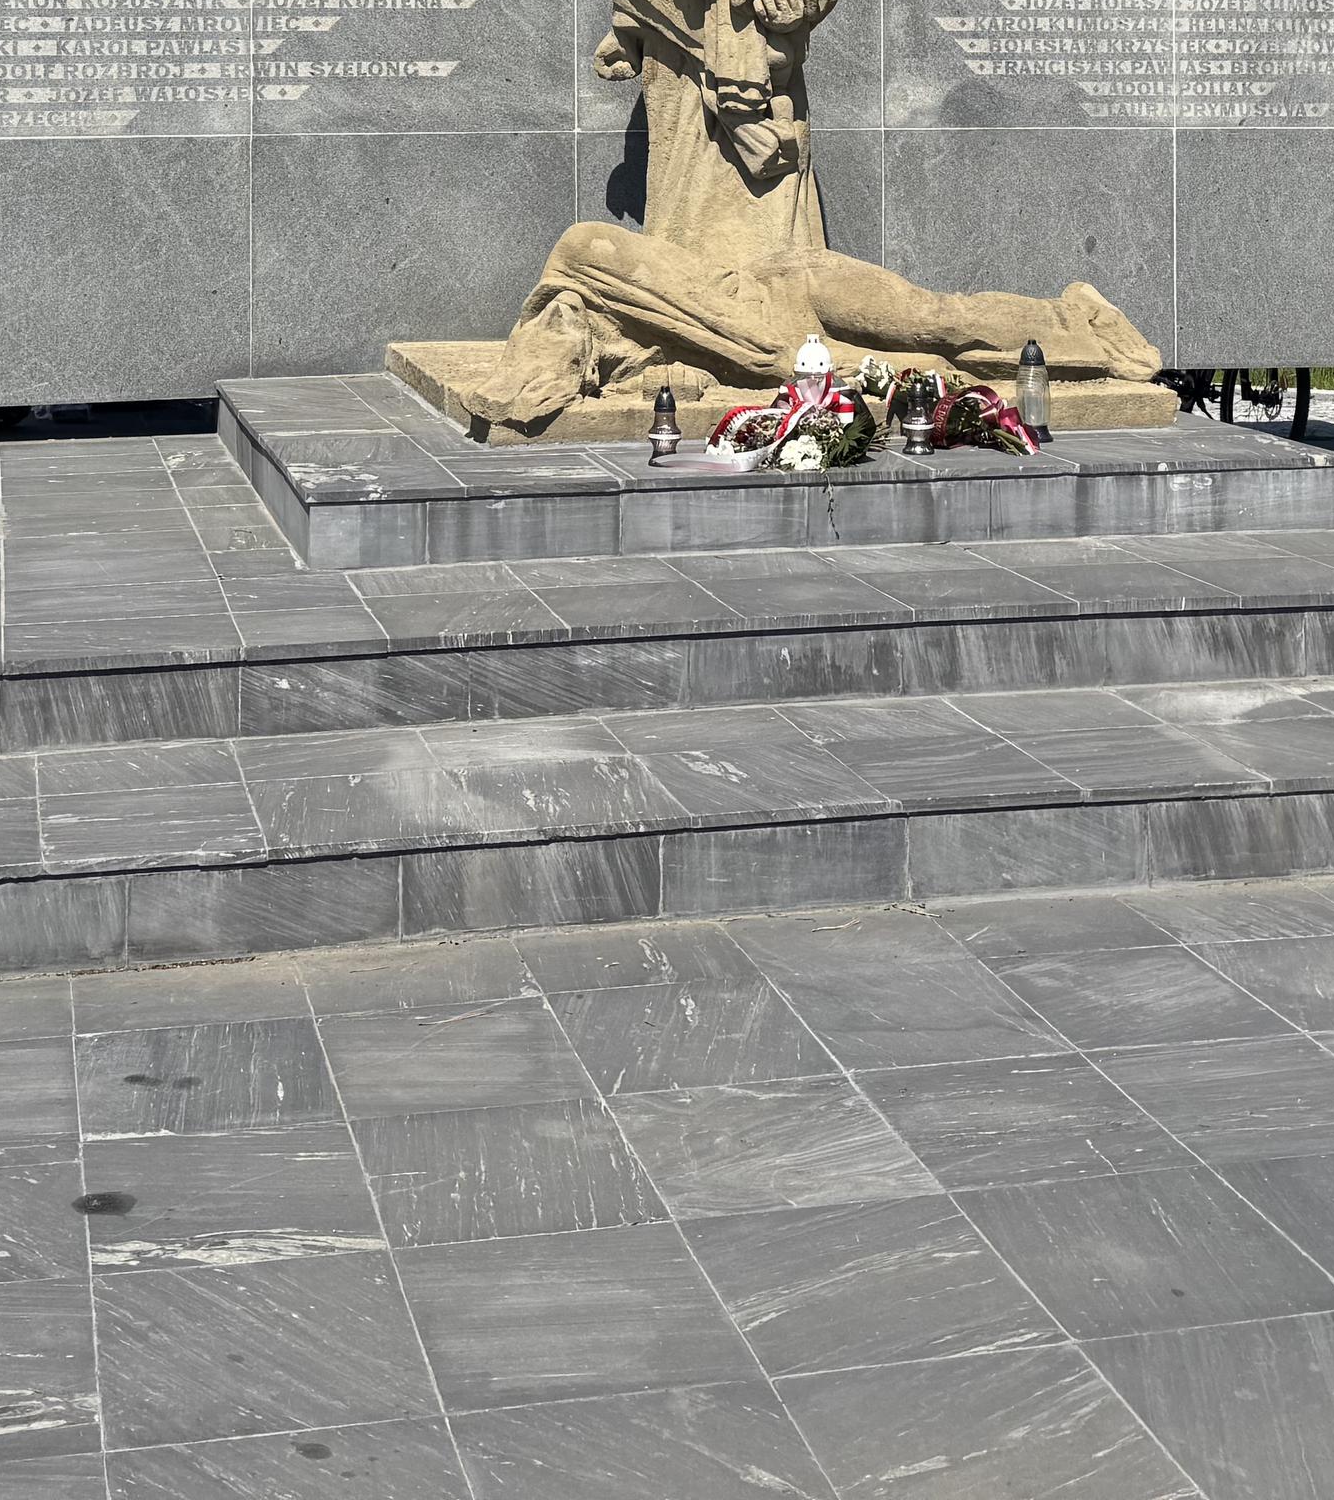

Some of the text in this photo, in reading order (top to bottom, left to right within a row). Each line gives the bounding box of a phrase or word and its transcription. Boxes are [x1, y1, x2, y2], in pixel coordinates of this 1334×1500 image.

[64, 16, 172, 33] TADEUSZ
[180, 16, 301, 33] MROWIEC
[974, 17, 1043, 32] KAROL
[1048, 18, 1169, 33] KLIMOSZEK
[1189, 18, 1260, 33] HELENA
[55, 40, 138, 56] KAROL
[146, 40, 239, 56] PAWLAS
[1107, 39, 1208, 54] KRZYSTEK
[63, 62, 184, 79] ROZBROJ
[220, 62, 298, 78] ERWIN
[309, 61, 419, 78] SZELONG
[992, 60, 1126, 75] FRANCISZEK
[1131, 60, 1211, 75] PAWLAS
[47, 86, 123, 103] JOZEF
[1109, 81, 1253, 97] ADOLF POLLAK
[1107, 103, 1307, 117] LAURA PRYMUSOVA
